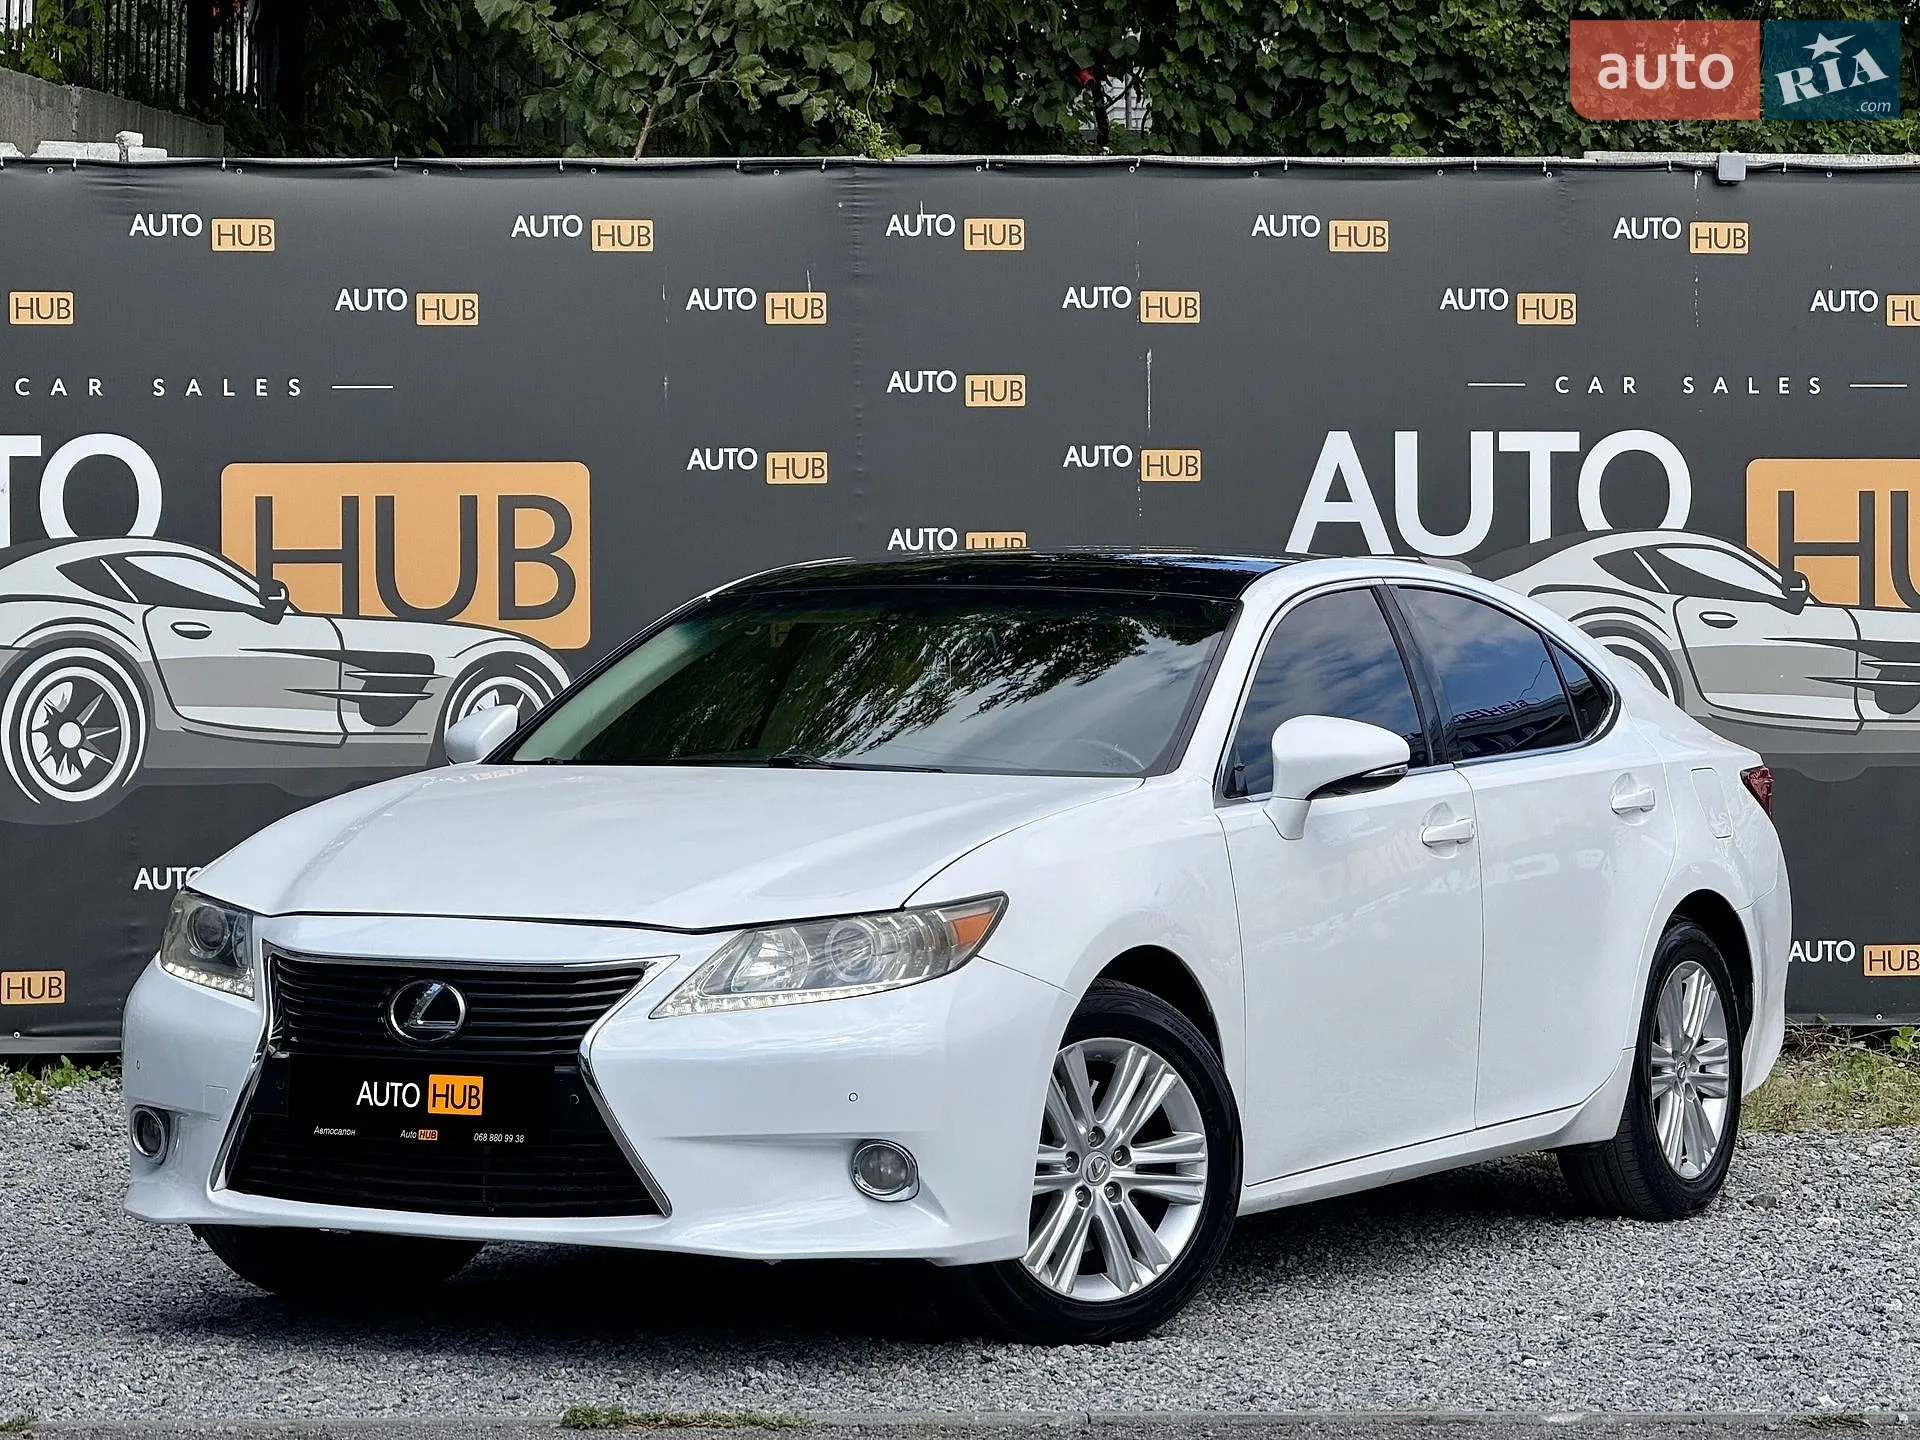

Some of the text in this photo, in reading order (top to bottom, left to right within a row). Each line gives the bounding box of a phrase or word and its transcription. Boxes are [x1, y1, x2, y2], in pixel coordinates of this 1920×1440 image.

[130, 214, 272, 246] AUTO HUB
[511, 215, 651, 246] AUTO HUB
[886, 214, 1022, 245] AUTO HUB
[1252, 215, 1386, 247] AUTO HUB
[1613, 217, 1746, 249] AUTO HUB
[16, 298, 70, 319] HUB
[335, 289, 475, 320] AUTO HUB
[686, 288, 824, 319] AUTO HUB
[1062, 286, 1197, 318] AUTO HUB
[1440, 288, 1573, 320] AUTO HUB
[1810, 290, 1878, 312] AUTO
[16, 378, 300, 396] CAR SALES
[887, 370, 1022, 401] AUTO HUB
[1556, 376, 1820, 394] CAR SALES
[687, 448, 825, 479] AUTO HUB
[1063, 445, 1198, 476] AUTO HUB
[1285, 430, 1920, 609] AUTO H
[888, 528, 957, 550] AUTO
[254, 494, 577, 621] HUB
[1789, 940, 1920, 971] AUTO HUB
[7, 977, 62, 999] HUB
[356, 1081, 480, 1109] AUTO HUB
[313, 1126, 356, 1136] Автосалон
[400, 1129, 437, 1140] Auto HUB
[473, 1132, 525, 1144] 068 880 99 38
